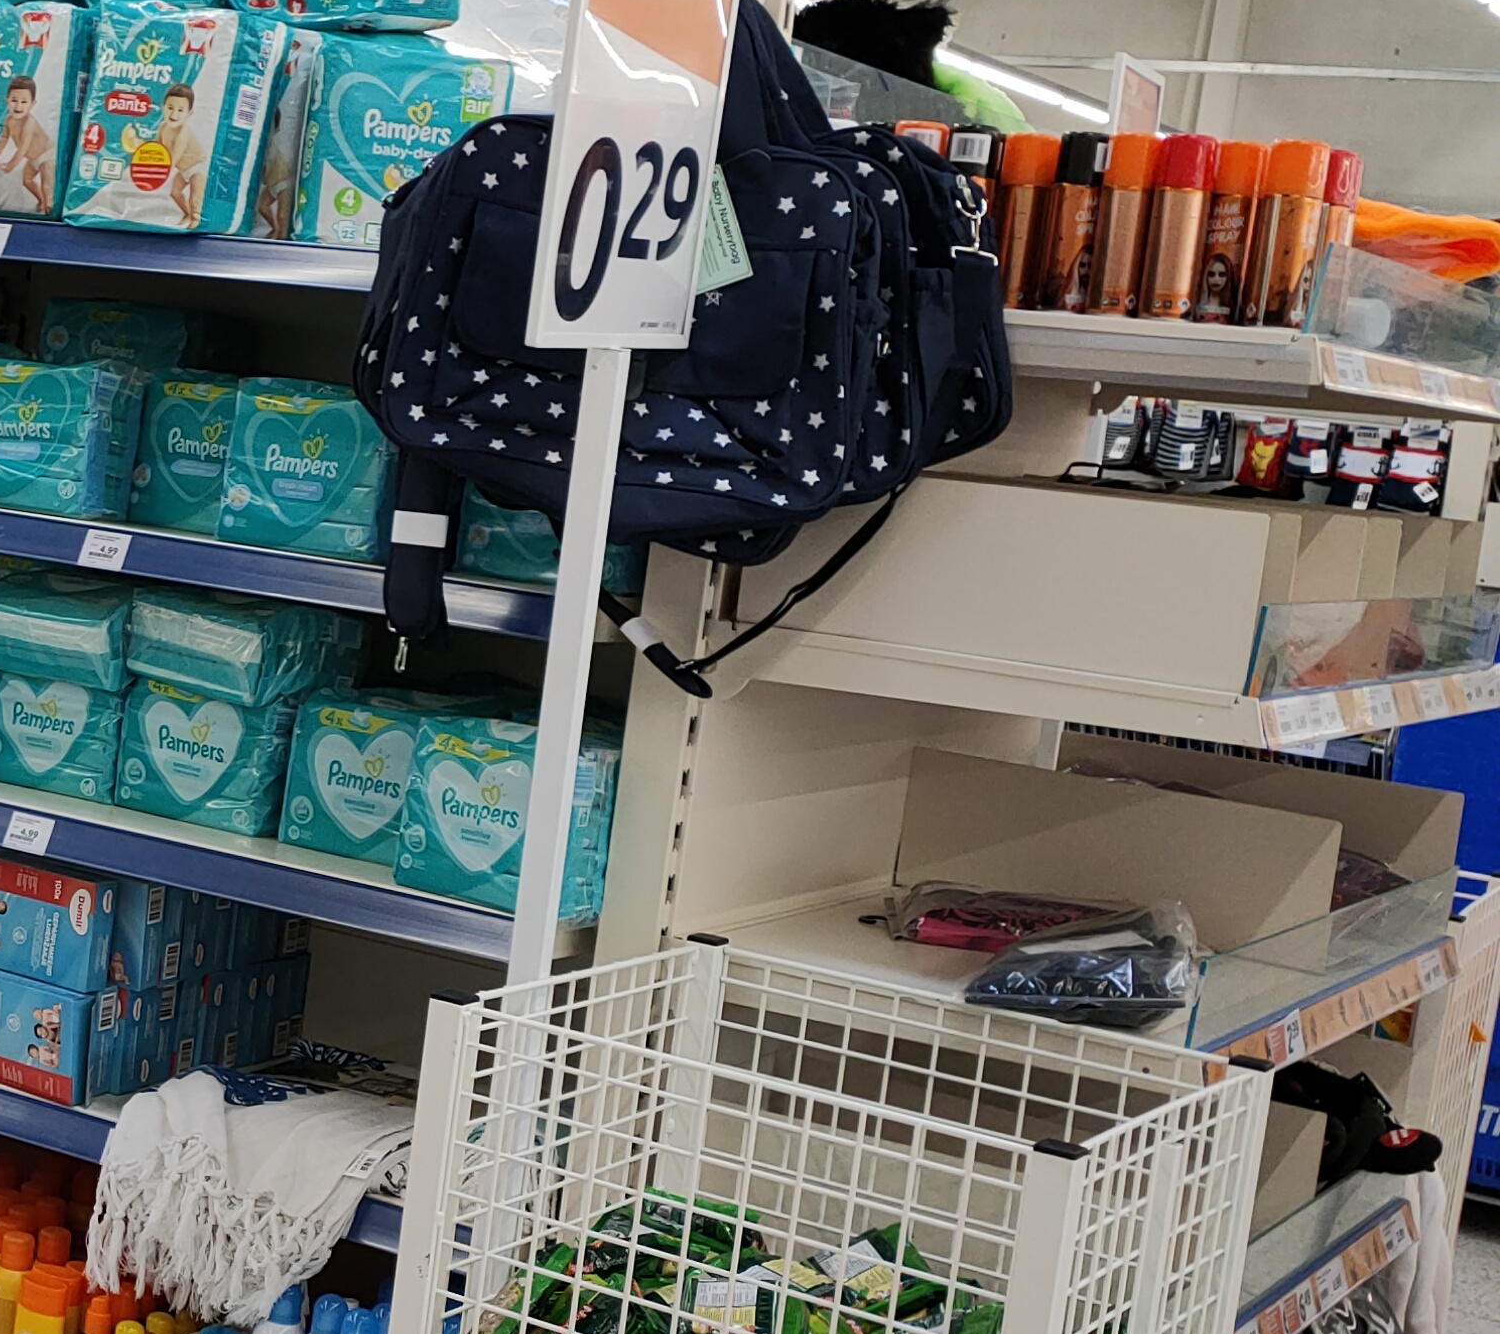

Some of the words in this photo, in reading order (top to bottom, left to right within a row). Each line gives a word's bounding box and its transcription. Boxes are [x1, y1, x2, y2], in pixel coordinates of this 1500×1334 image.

[97, 48, 172, 84] Pampers
[107, 98, 149, 113] pants
[464, 98, 491, 116] air
[363, 108, 453, 146] Pampers
[264, 442, 339, 479] Pampers
[98, 544, 119, 557] 4.99
[11, 700, 76, 736] Pampers
[158, 724, 226, 763] Pampers
[327, 760, 402, 800] Pampers
[441, 787, 521, 831] Pampers
[19, 828, 40, 841] 4.99
[75, 895, 87, 929] Dumil
